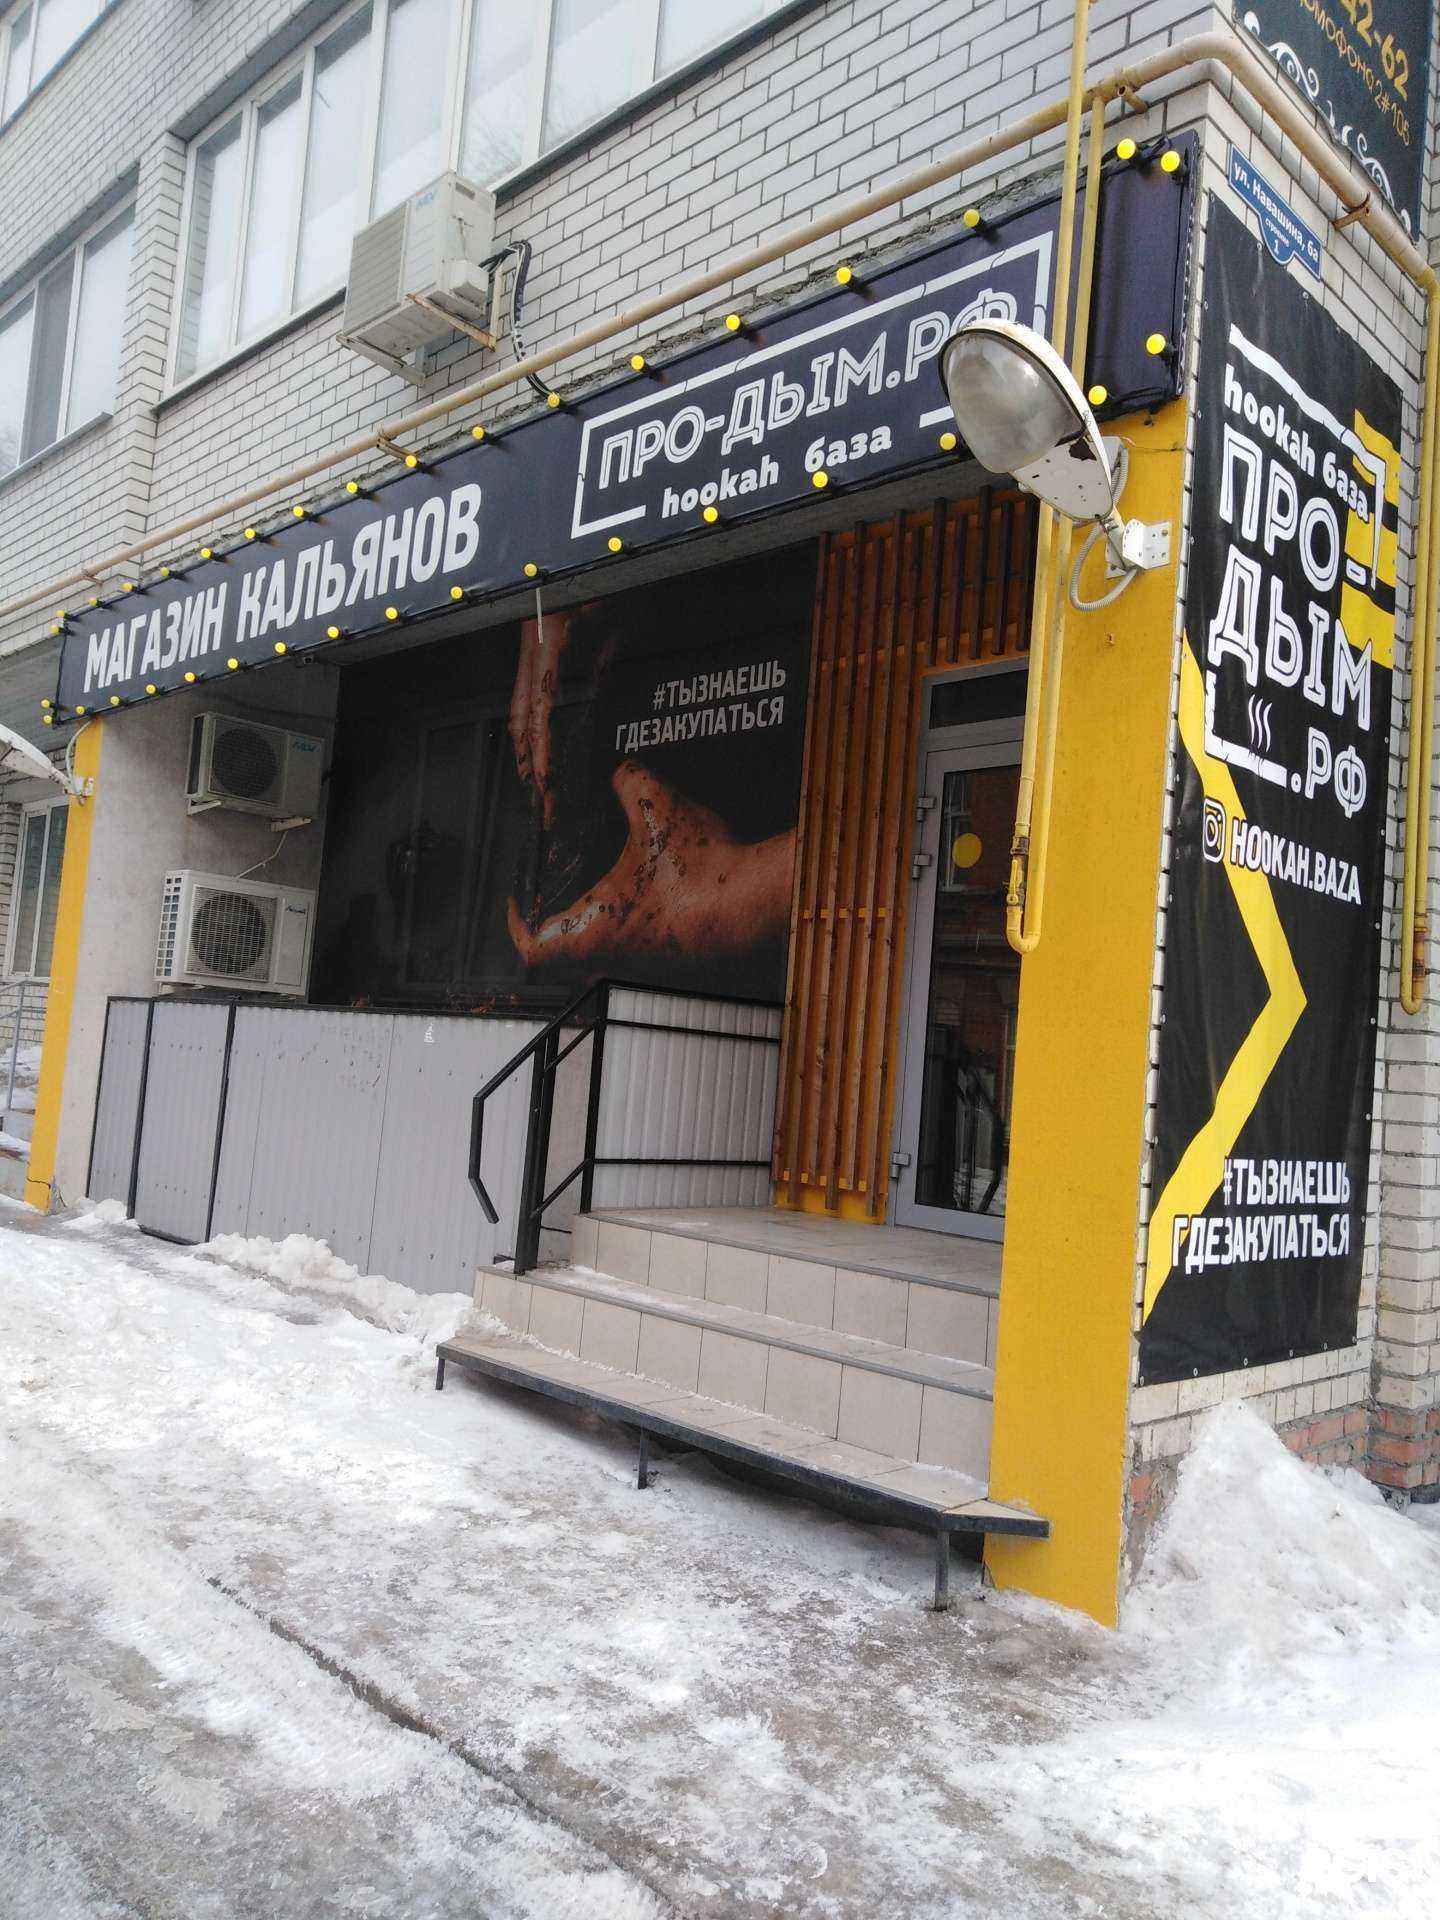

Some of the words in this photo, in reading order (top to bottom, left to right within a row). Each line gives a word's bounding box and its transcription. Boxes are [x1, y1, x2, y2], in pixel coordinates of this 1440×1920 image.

[1234, 162, 1250, 189] ул.
[1252, 178, 1305, 252] Навашина,
[1307, 240, 1320, 263] 6а
[1274, 239, 1280, 256] 1
[661, 453, 779, 520] hookah
[803, 425, 893, 475] база
[1224, 363, 1316, 478] hookah
[1322, 451, 1370, 524] база
[1219, 422, 1367, 593] ПРО-
[83, 581, 228, 694] МАГАЗИН
[236, 483, 483, 644] КАЛЬЯНОВ
[1207, 543, 1373, 732] ДЫМ
[615, 695, 785, 753] ГДЕЗАКУПАТЬСЯ
[652, 660, 787, 711] #ТЫЗНАЕШЬ
[1291, 725, 1368, 819] .РФ
[1230, 817, 1362, 906] HOOKAH.BAZA
[1223, 1158, 1350, 1206] #ТЫЗНАЕШЬ
[1172, 1213, 1350, 1275] ГДЕЗАКУПАТЬСЯ
